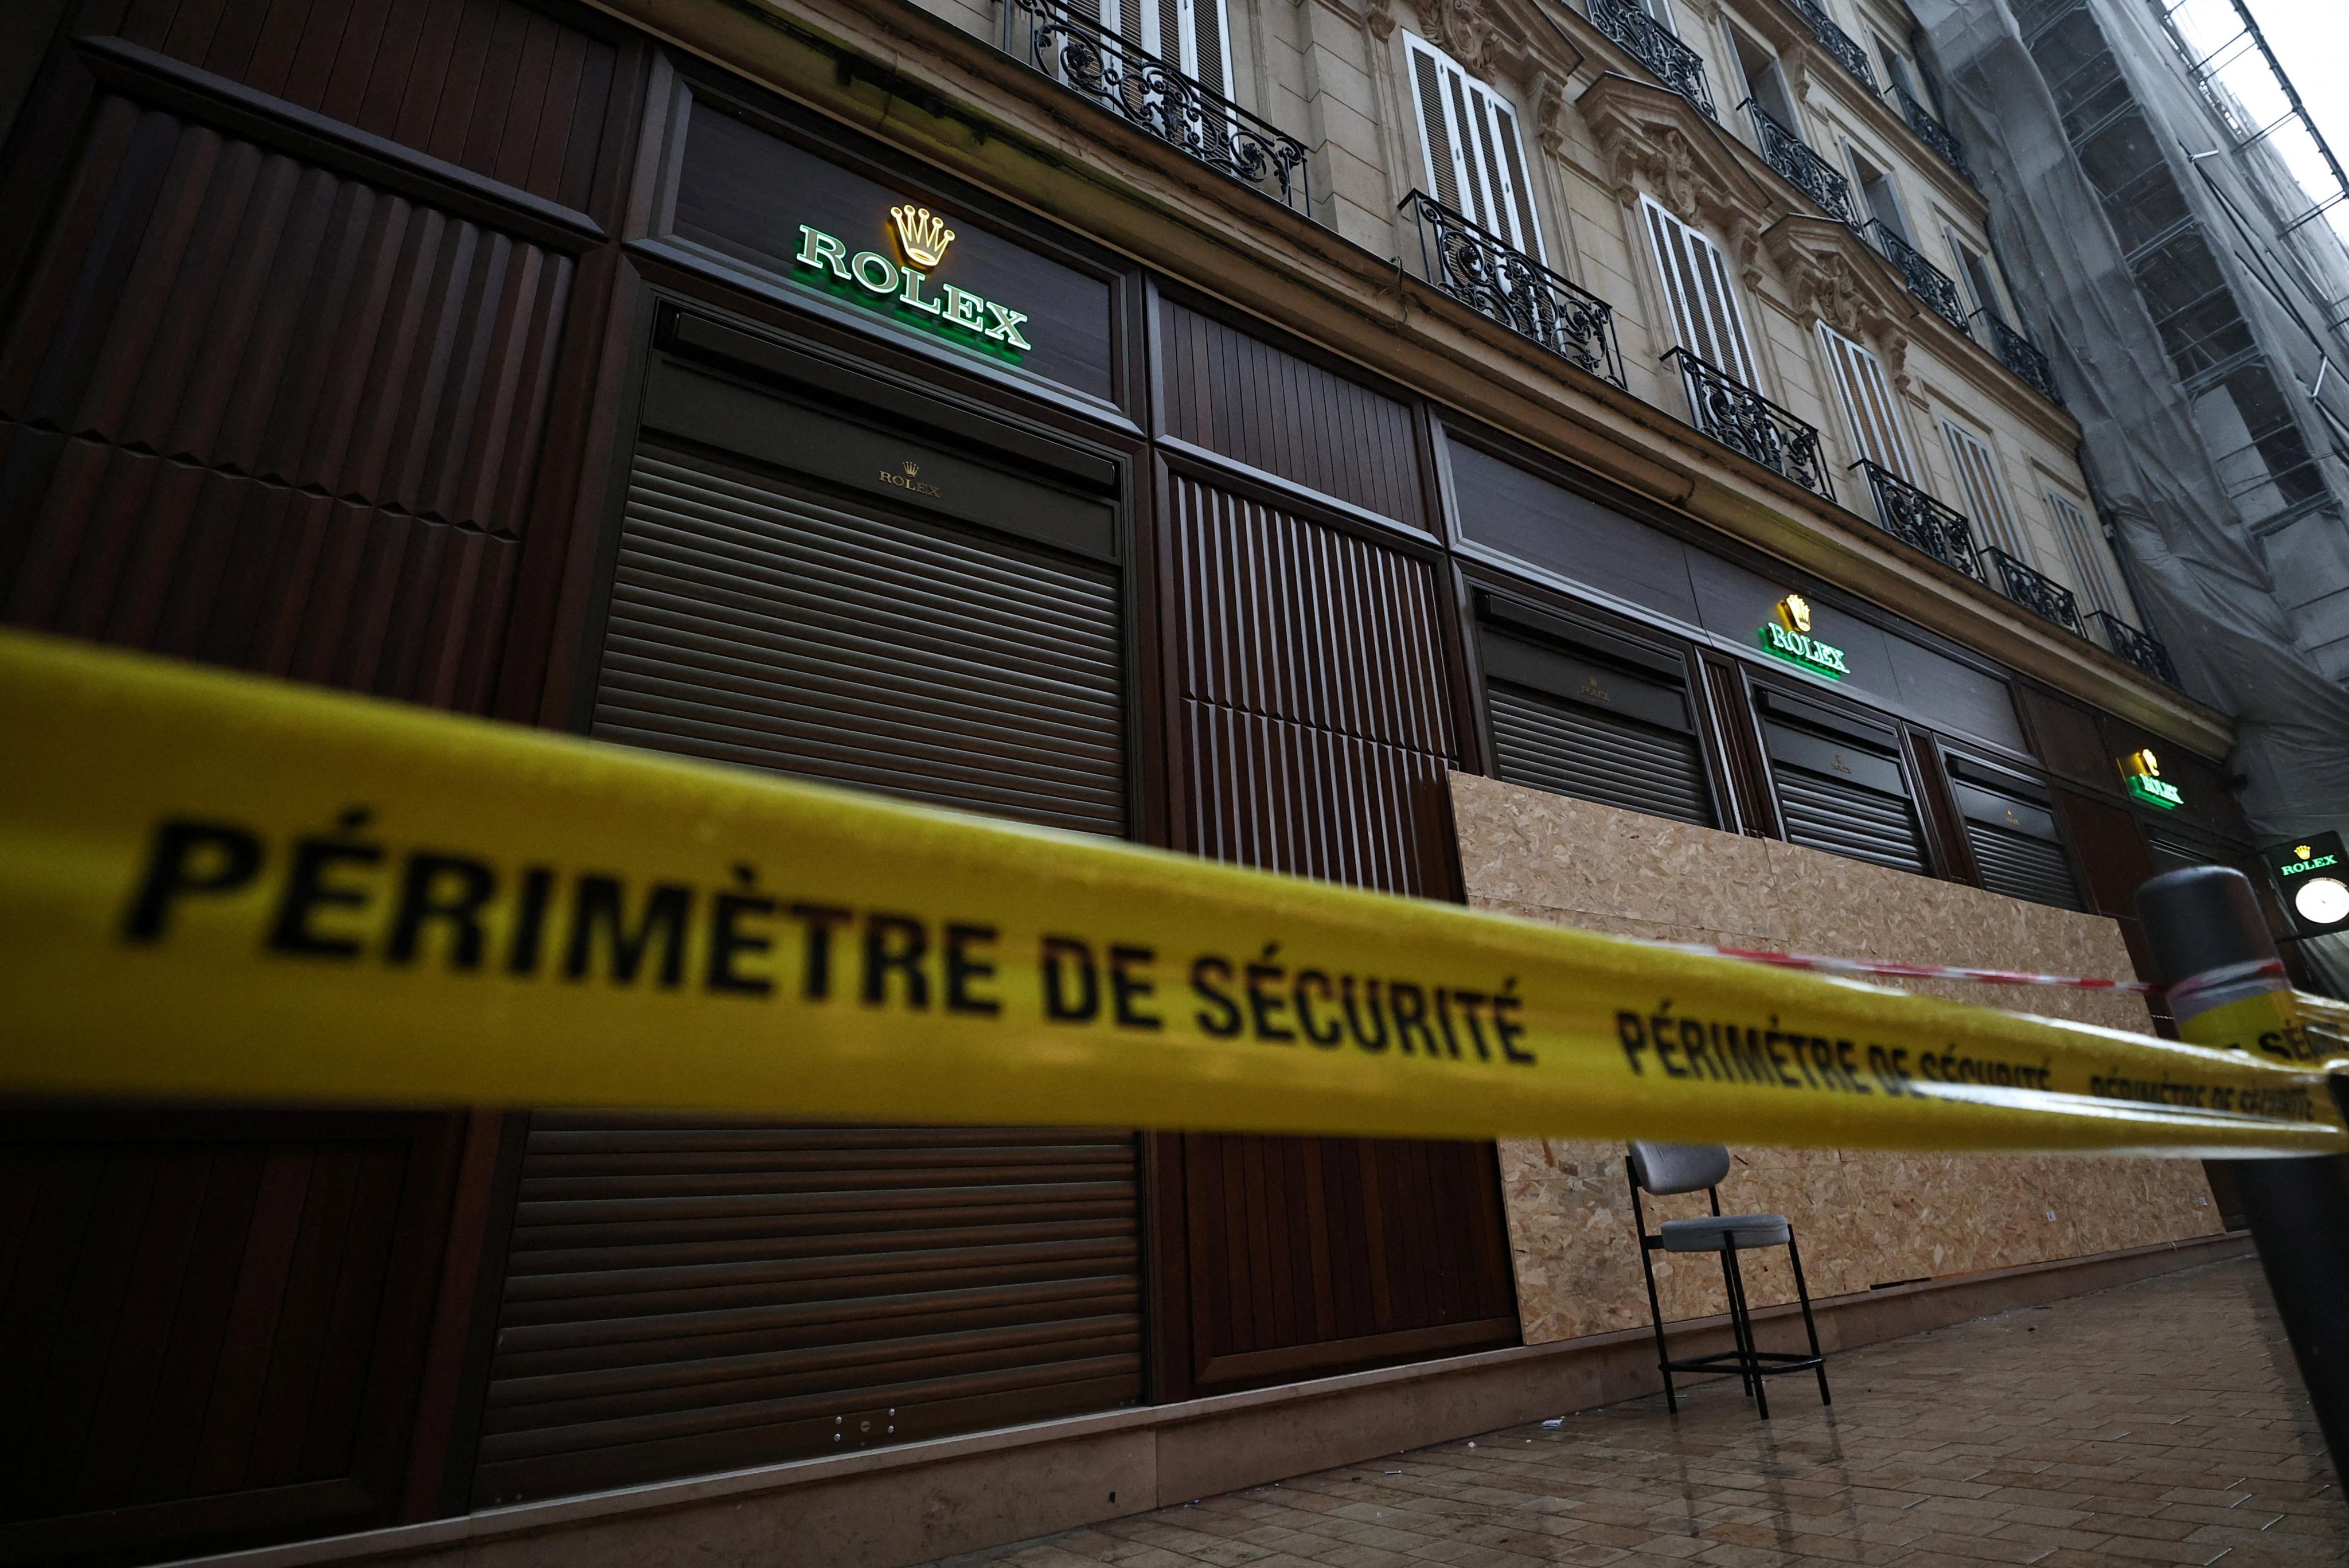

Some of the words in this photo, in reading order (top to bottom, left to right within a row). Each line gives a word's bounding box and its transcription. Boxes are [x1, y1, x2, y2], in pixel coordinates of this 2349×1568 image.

[797, 224, 1031, 350] ROLEX
[879, 470, 941, 498] ROLEX
[1768, 622, 1851, 674] ROLEX
[2281, 855, 2338, 876] ROLEX
[123, 805, 1002, 1017] PÉRIMÈTRE
[1040, 935, 1165, 1032] DE
[1188, 943, 1536, 1066] SÉCURITÉ
